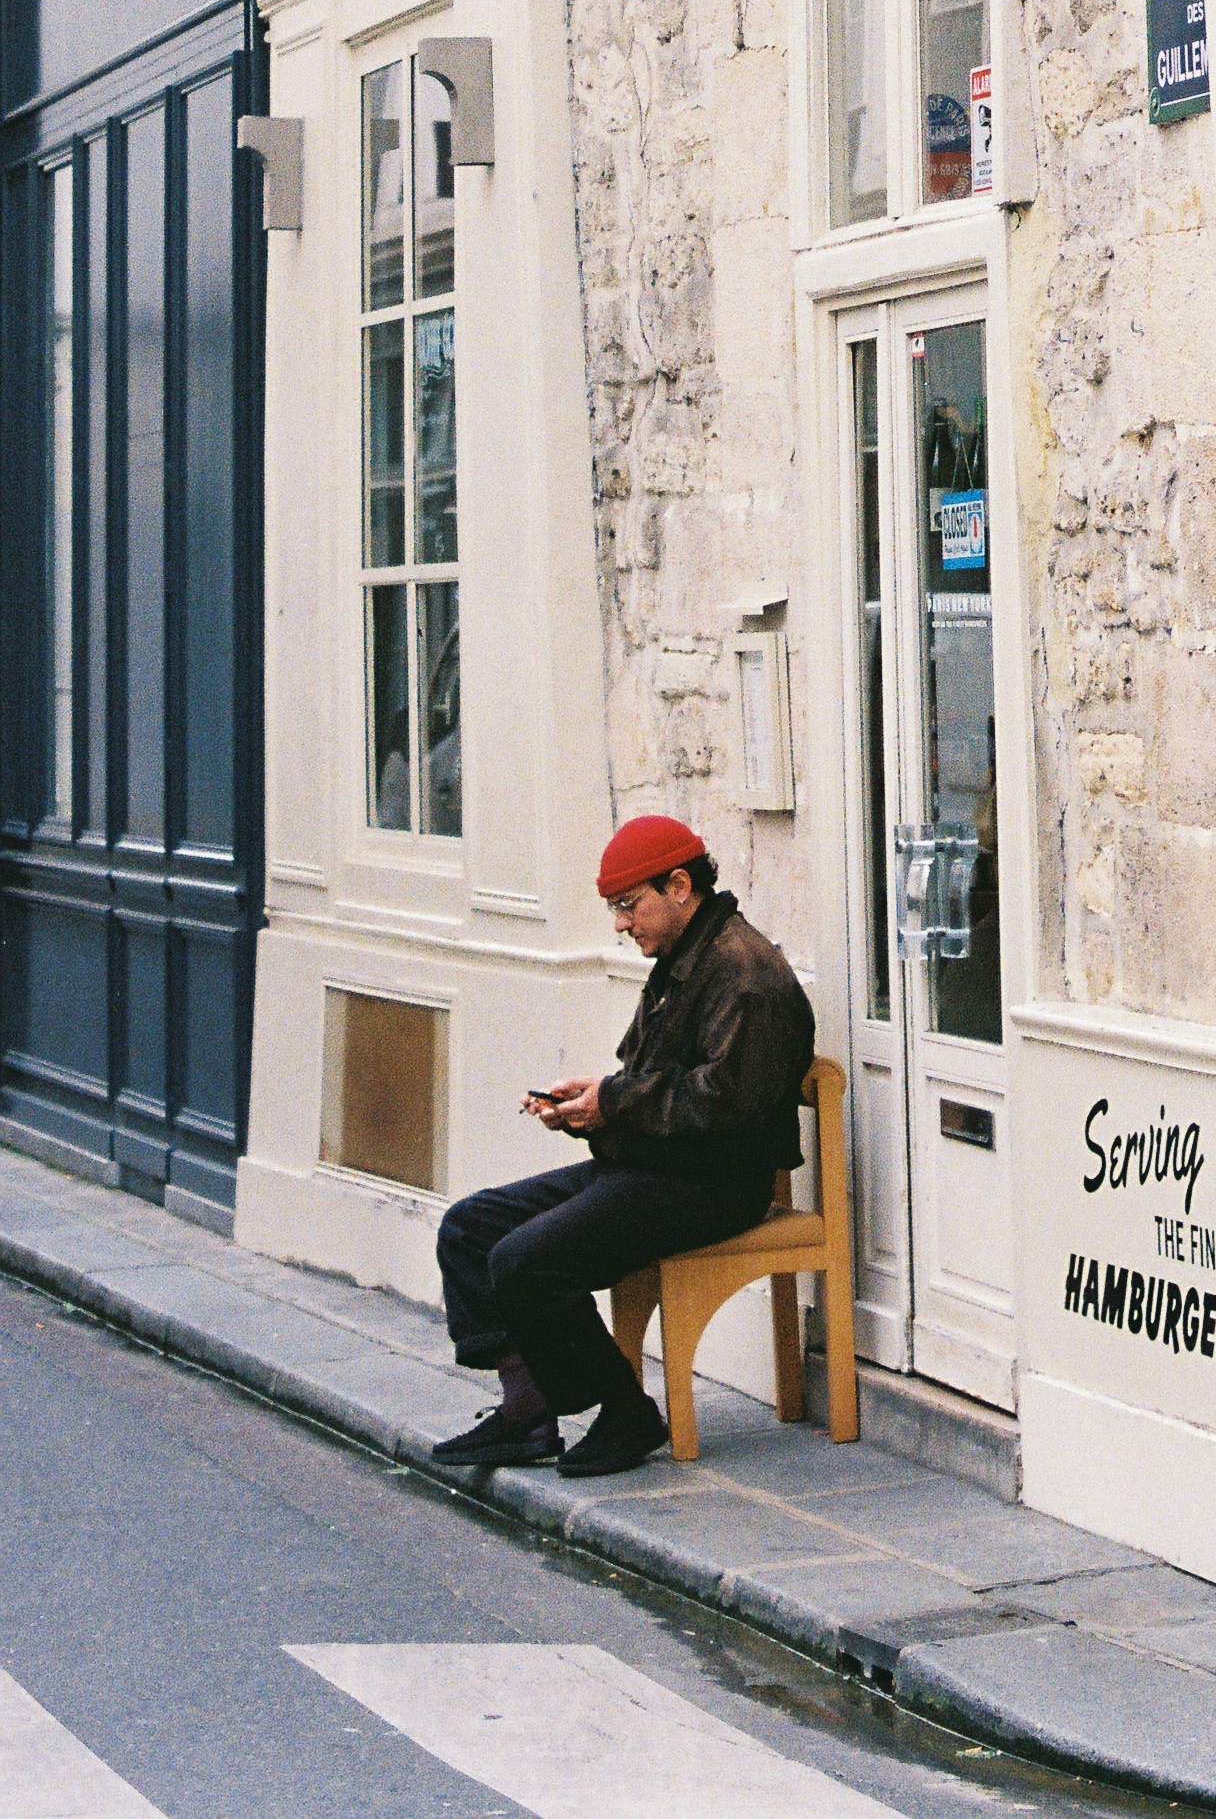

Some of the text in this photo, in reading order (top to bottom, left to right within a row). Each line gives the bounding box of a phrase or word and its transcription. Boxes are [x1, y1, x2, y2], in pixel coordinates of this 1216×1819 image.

[1187, 1, 1204, 24] DES
[1083, 1098, 1204, 1216] Serving
[1155, 1216, 1185, 1263] THE
